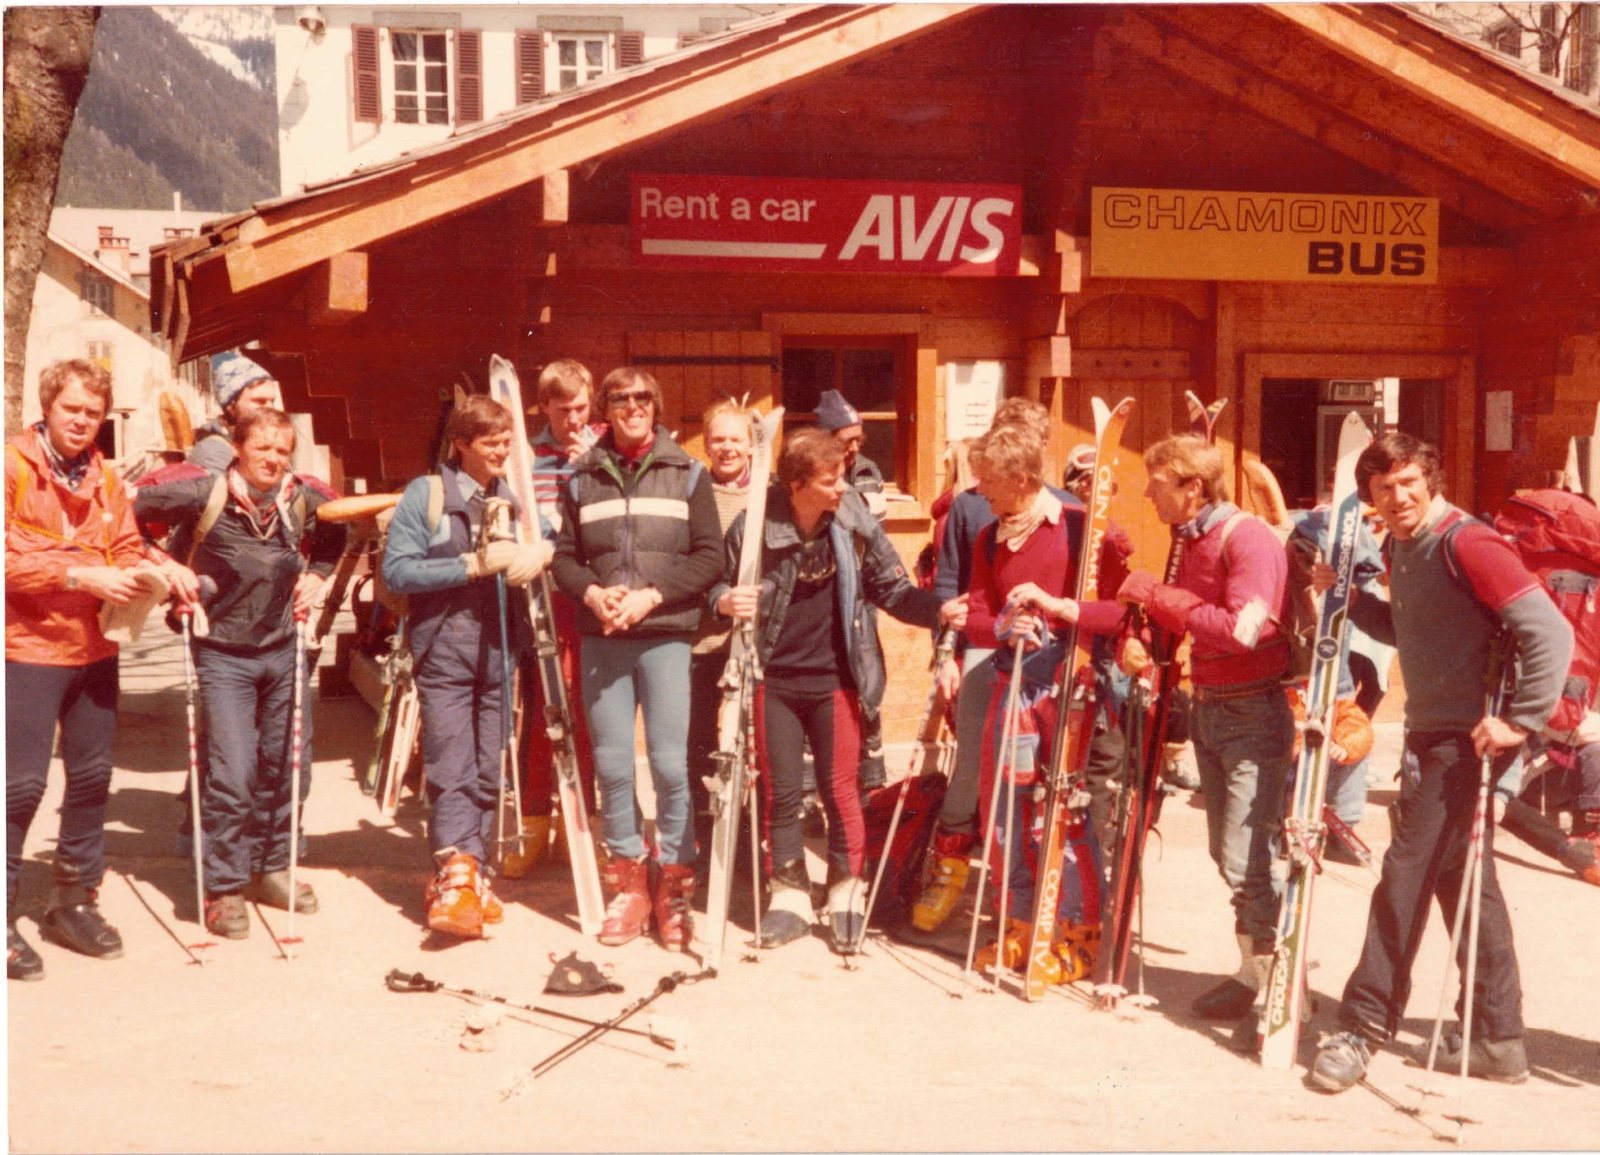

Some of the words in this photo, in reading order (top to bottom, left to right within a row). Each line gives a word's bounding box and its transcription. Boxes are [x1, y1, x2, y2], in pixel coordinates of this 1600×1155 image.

[641, 187, 719, 220] Rent
[731, 198, 751, 221] a
[760, 198, 816, 223] car
[837, 194, 1014, 264] AVIS
[1103, 194, 1427, 236] CHAMONIX
[1307, 241, 1426, 277] BUS
[1094, 465, 1111, 519] OLIN
[1086, 528, 1103, 591] MARK
[1334, 506, 1357, 598] ROSSIGNOL
[1039, 868, 1060, 935] COMP
